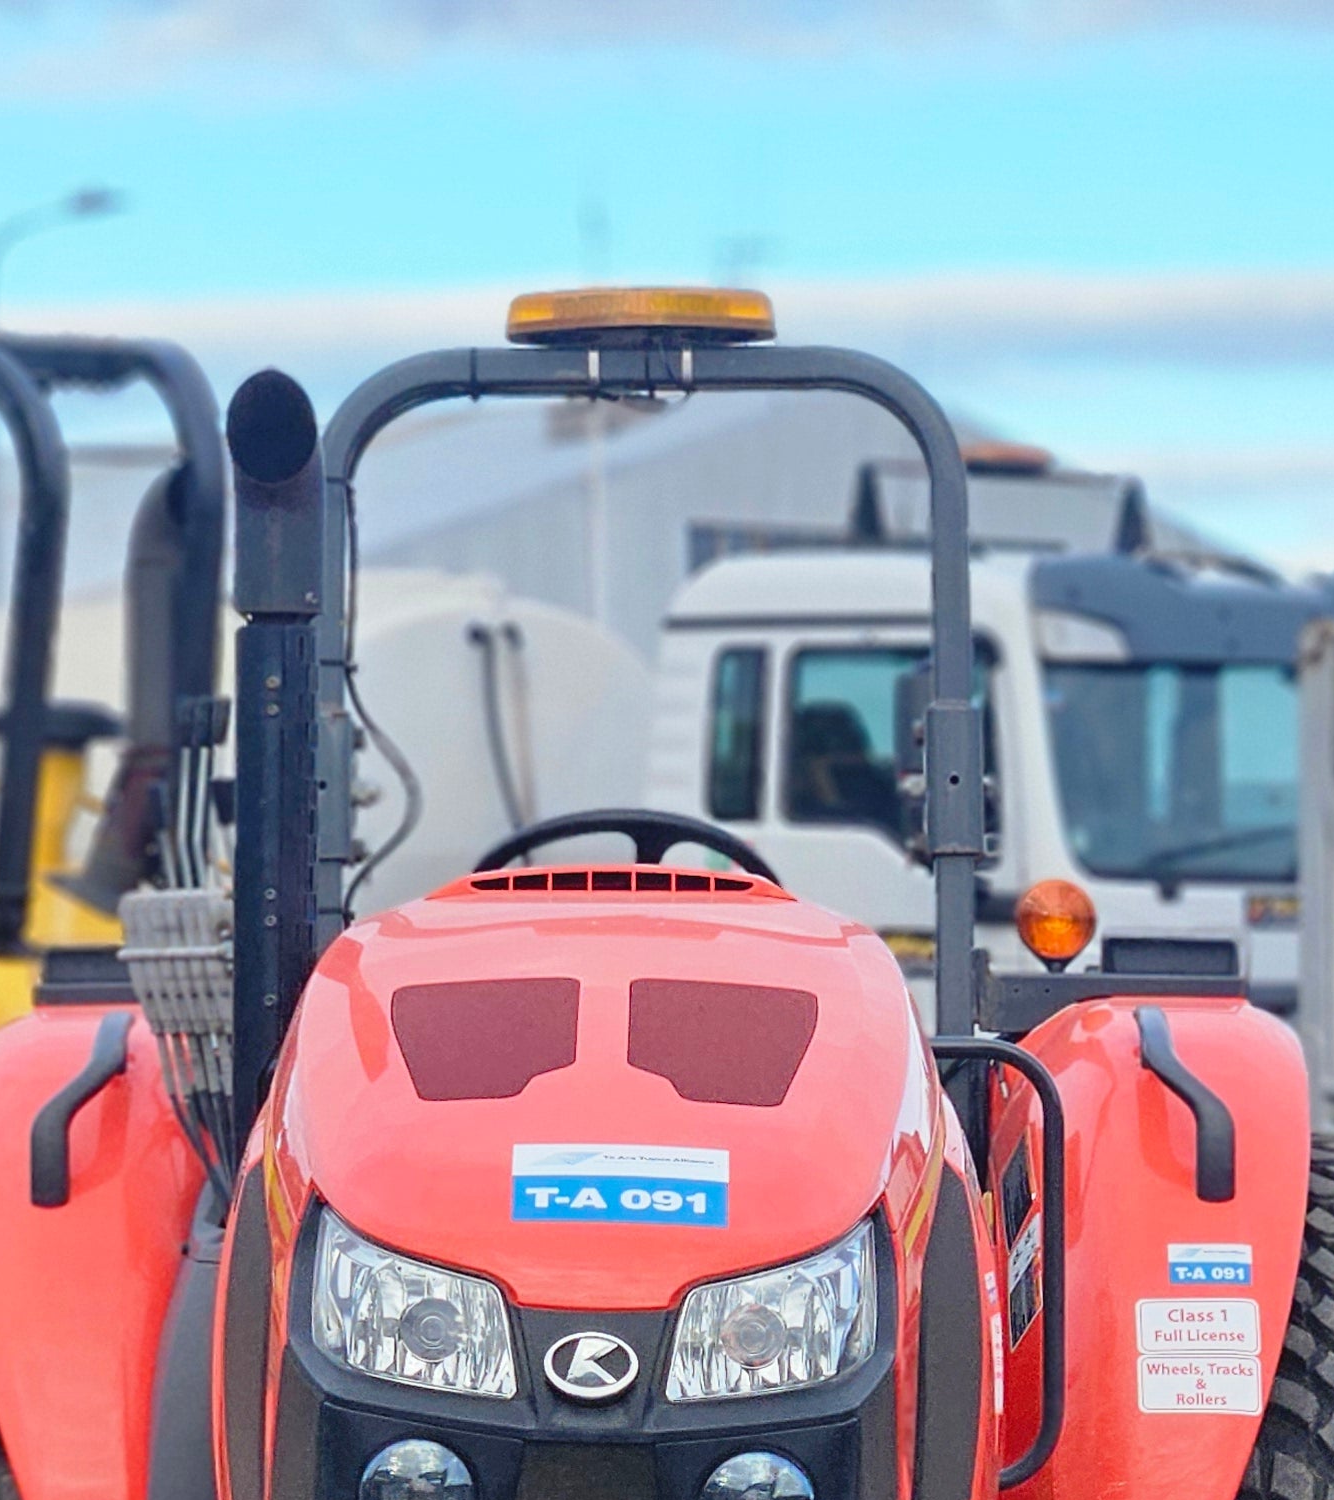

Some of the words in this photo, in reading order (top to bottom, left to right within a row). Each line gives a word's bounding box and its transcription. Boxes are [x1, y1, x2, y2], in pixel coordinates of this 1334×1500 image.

[525, 1186, 608, 1210] T-A
[620, 1188, 708, 1214] 091
[1175, 1267, 1206, 1280] T-A
[1211, 1267, 1245, 1281] 091
[1168, 1309, 1214, 1323] Class
[1220, 1309, 1229, 1323] 1
[1154, 1329, 1183, 1343] Full
[1187, 1329, 1246, 1343] License
[1146, 1363, 1204, 1376] Wheels,
[1208, 1363, 1254, 1377] Tracks
[1195, 1378, 1207, 1391] &
[1176, 1393, 1227, 1406] Rollers
